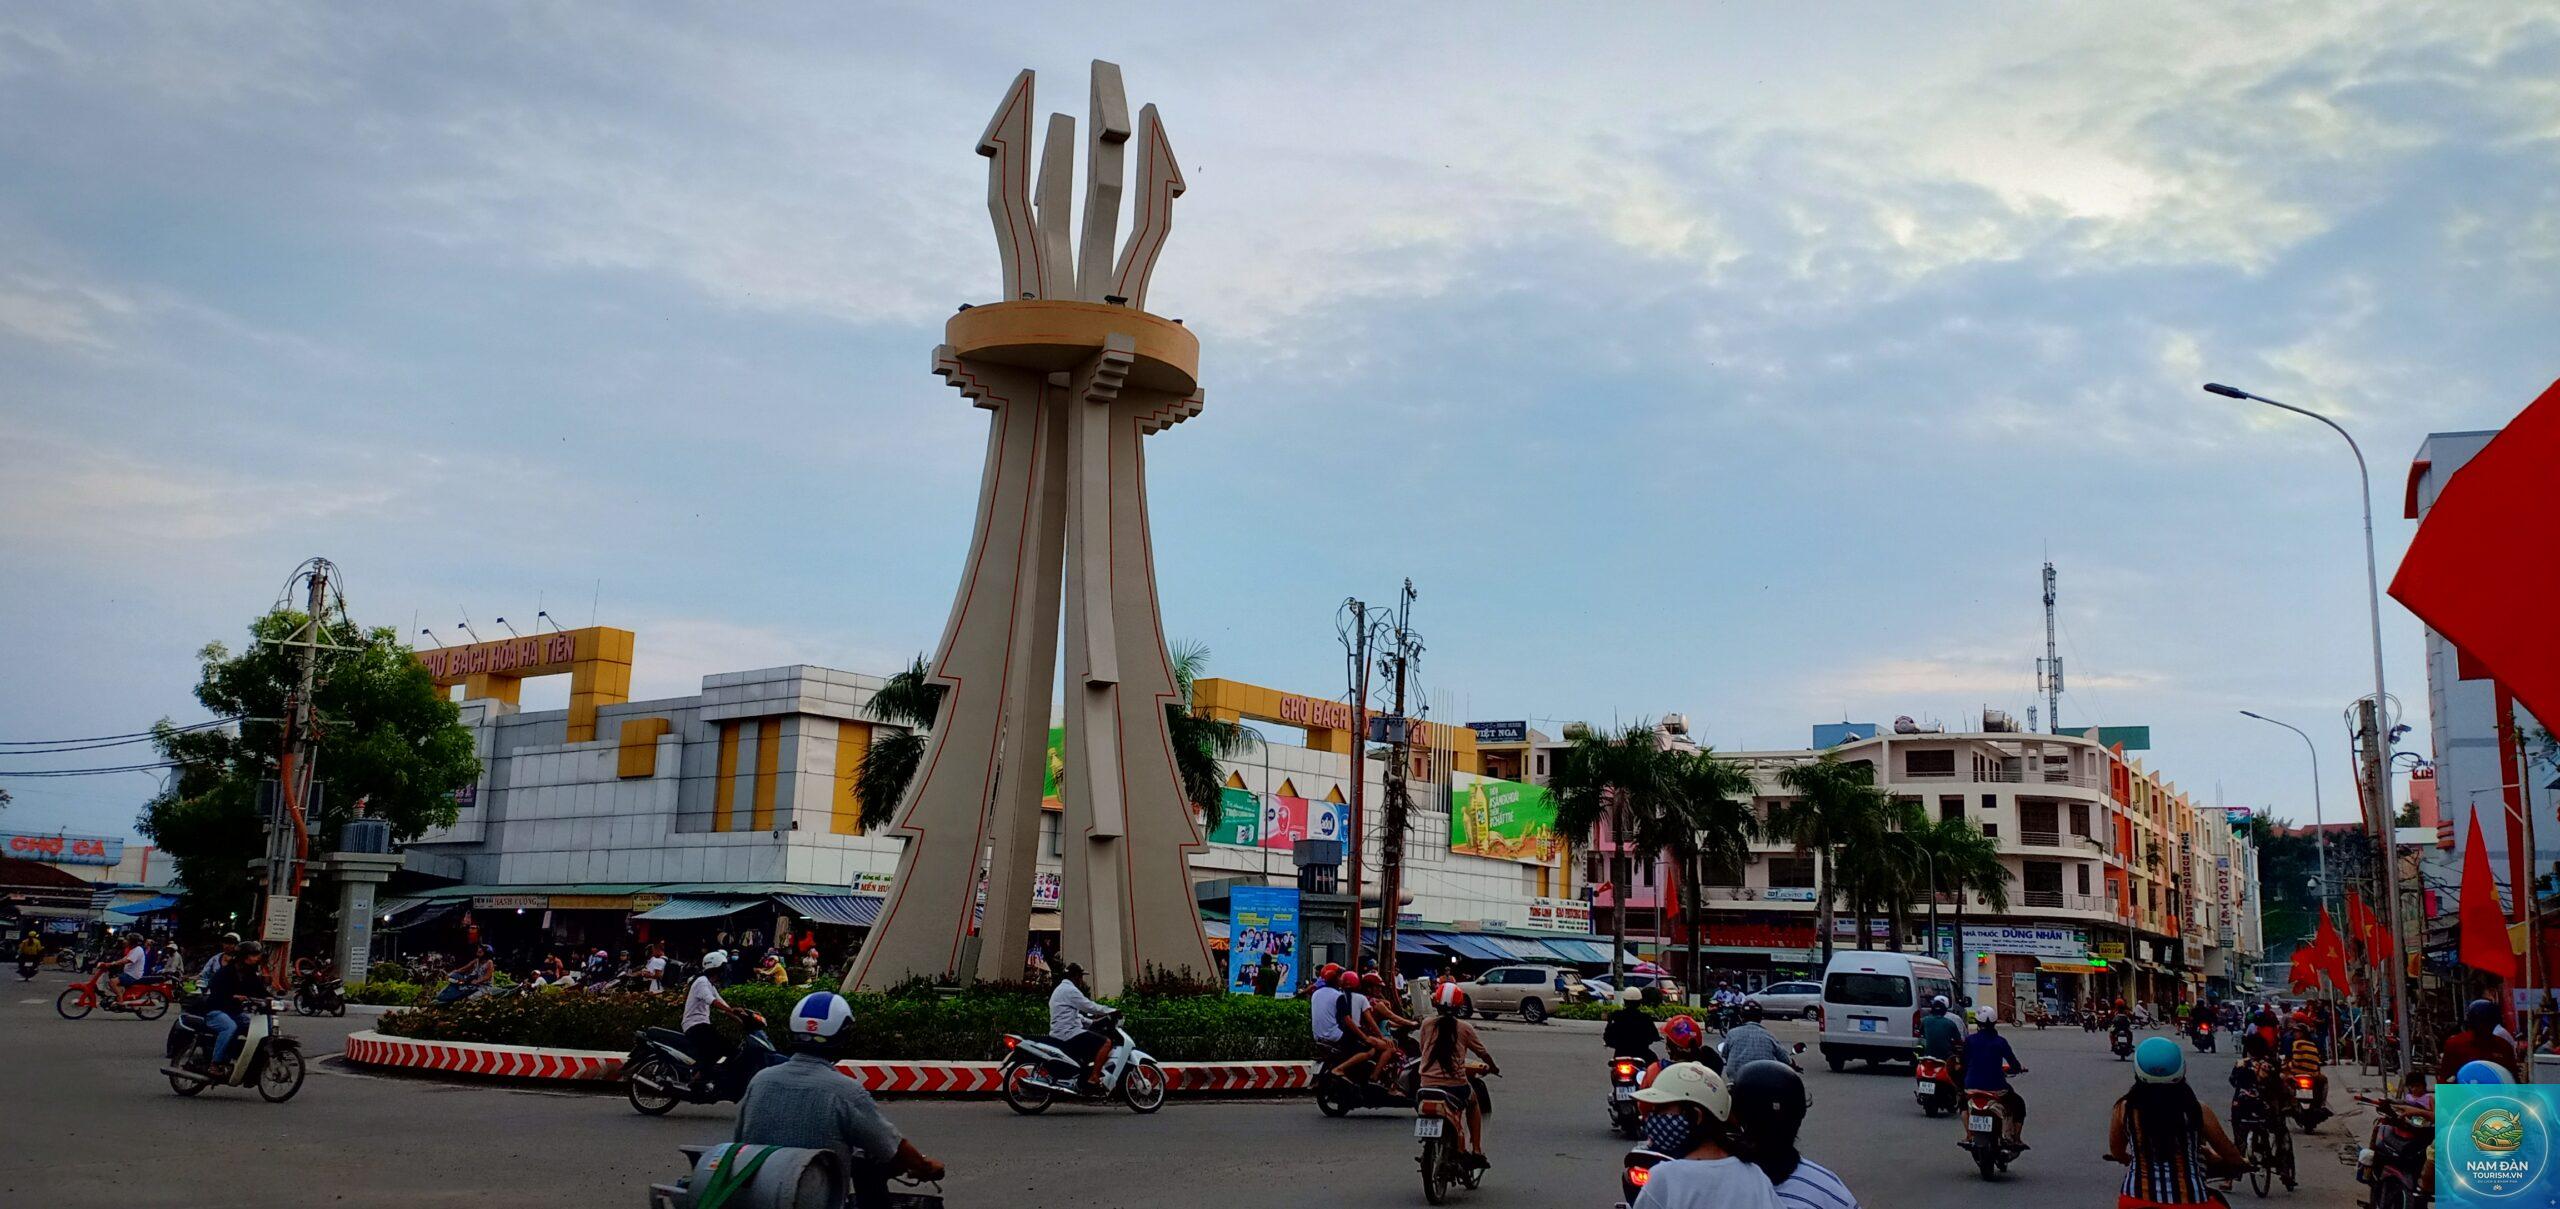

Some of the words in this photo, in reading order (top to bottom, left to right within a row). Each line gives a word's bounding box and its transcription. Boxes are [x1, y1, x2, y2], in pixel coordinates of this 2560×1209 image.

[451, 645, 488, 676] BÁCH
[492, 640, 518, 671] HÓA
[545, 634, 575, 664] TIÊN
[1281, 696, 1308, 724] CHỢ
[1313, 700, 1347, 729] BÁCH
[1498, 728, 1518, 737] NGA
